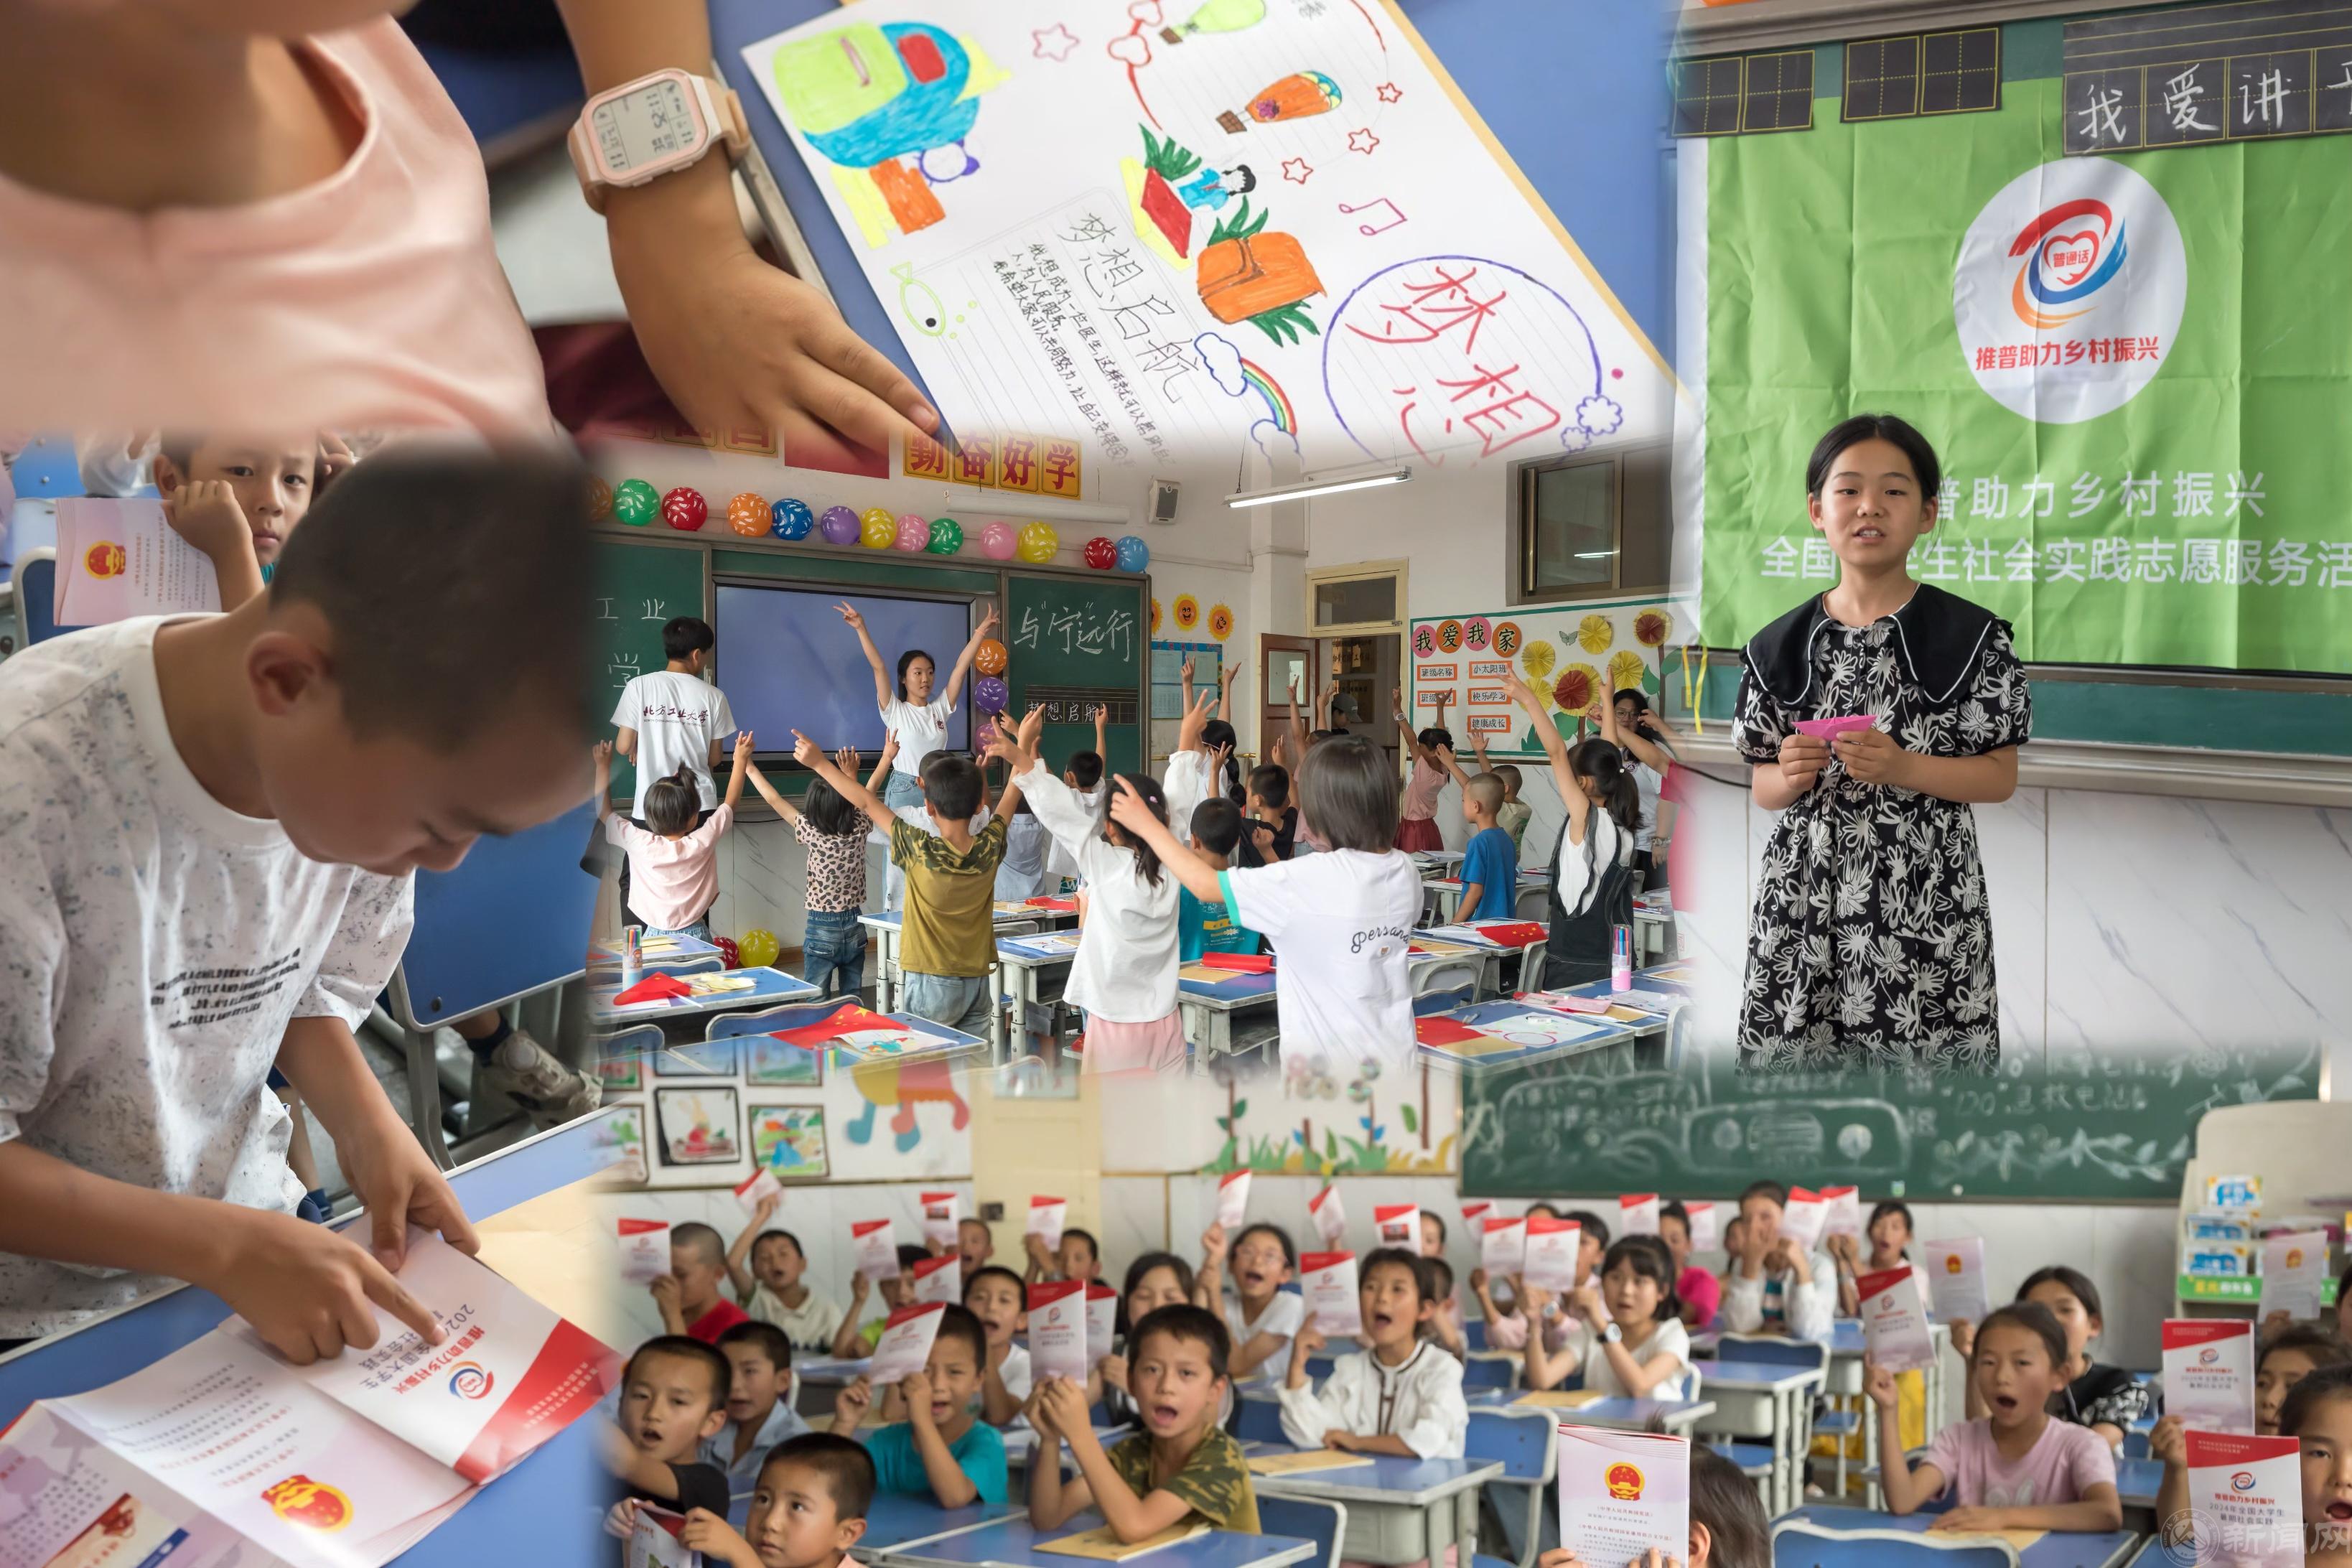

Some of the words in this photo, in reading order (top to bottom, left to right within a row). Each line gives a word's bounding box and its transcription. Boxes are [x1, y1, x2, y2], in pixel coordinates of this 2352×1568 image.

[2053, 249, 2090, 268] 普通话
[1975, 336, 2159, 370] 推普助力乡村振兴
[1415, 622, 1516, 652] 我爱我家
[1421, 668, 1453, 677] 班级名称
[1473, 664, 1507, 673] 小太阳班
[1473, 691, 1506, 701] 快乐学习
[1472, 719, 1506, 728] 健康成长
